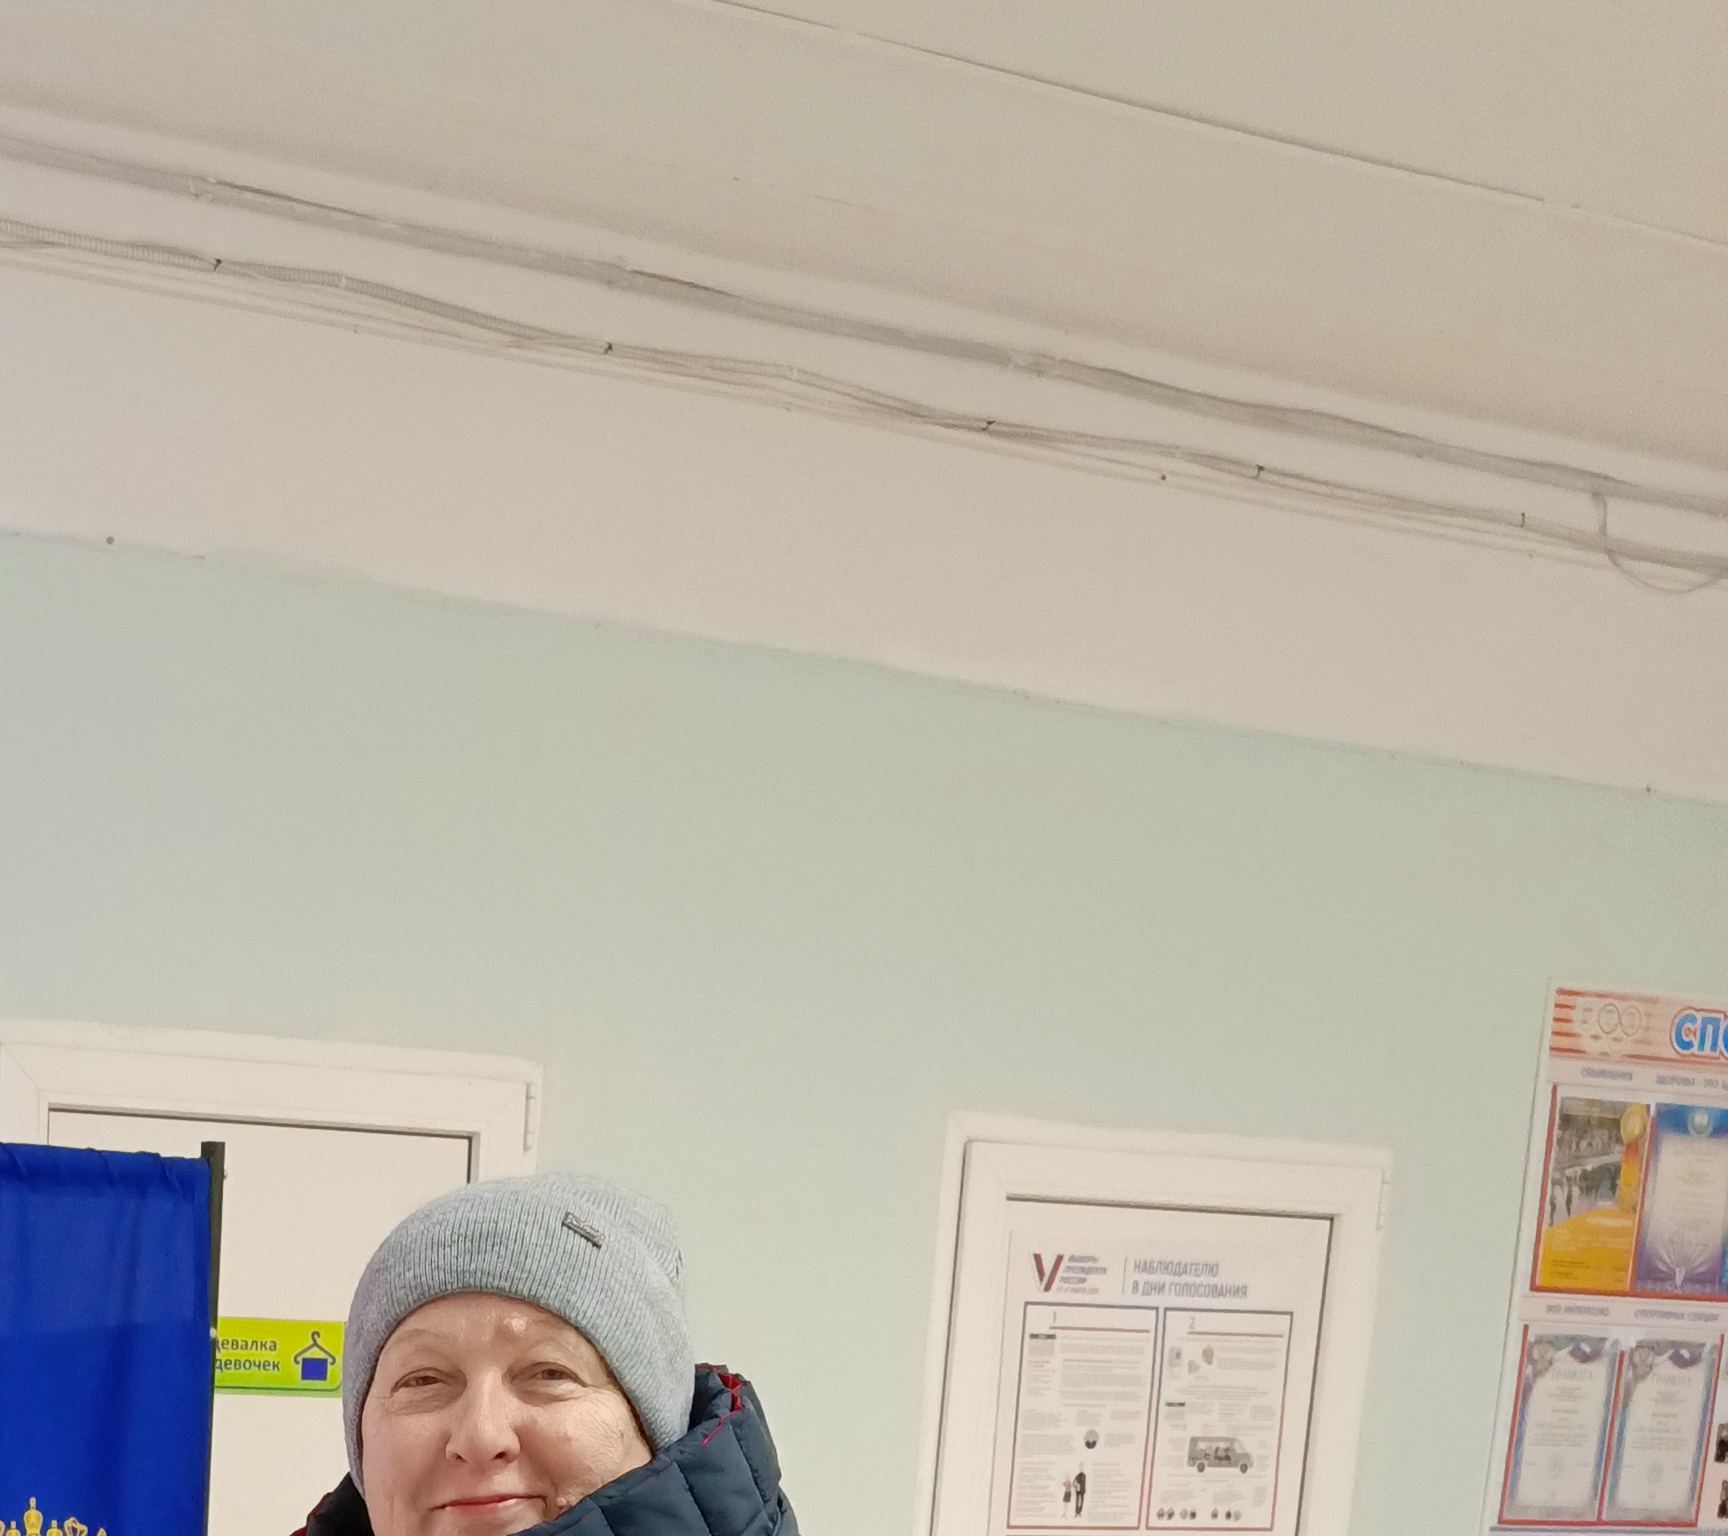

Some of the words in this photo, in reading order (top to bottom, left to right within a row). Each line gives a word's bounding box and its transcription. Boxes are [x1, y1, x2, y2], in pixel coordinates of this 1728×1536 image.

[1674, 1013, 1728, 1054] СП
[1133, 1259, 1219, 1278] НАБЛЮДАТЕЛЮ
[1132, 1280, 1139, 1294] В
[1142, 1281, 1165, 1297] ДНИ
[1168, 1282, 1248, 1299] ГОЛОСОВАНИЯ
[215, 1358, 280, 1372] девочек
